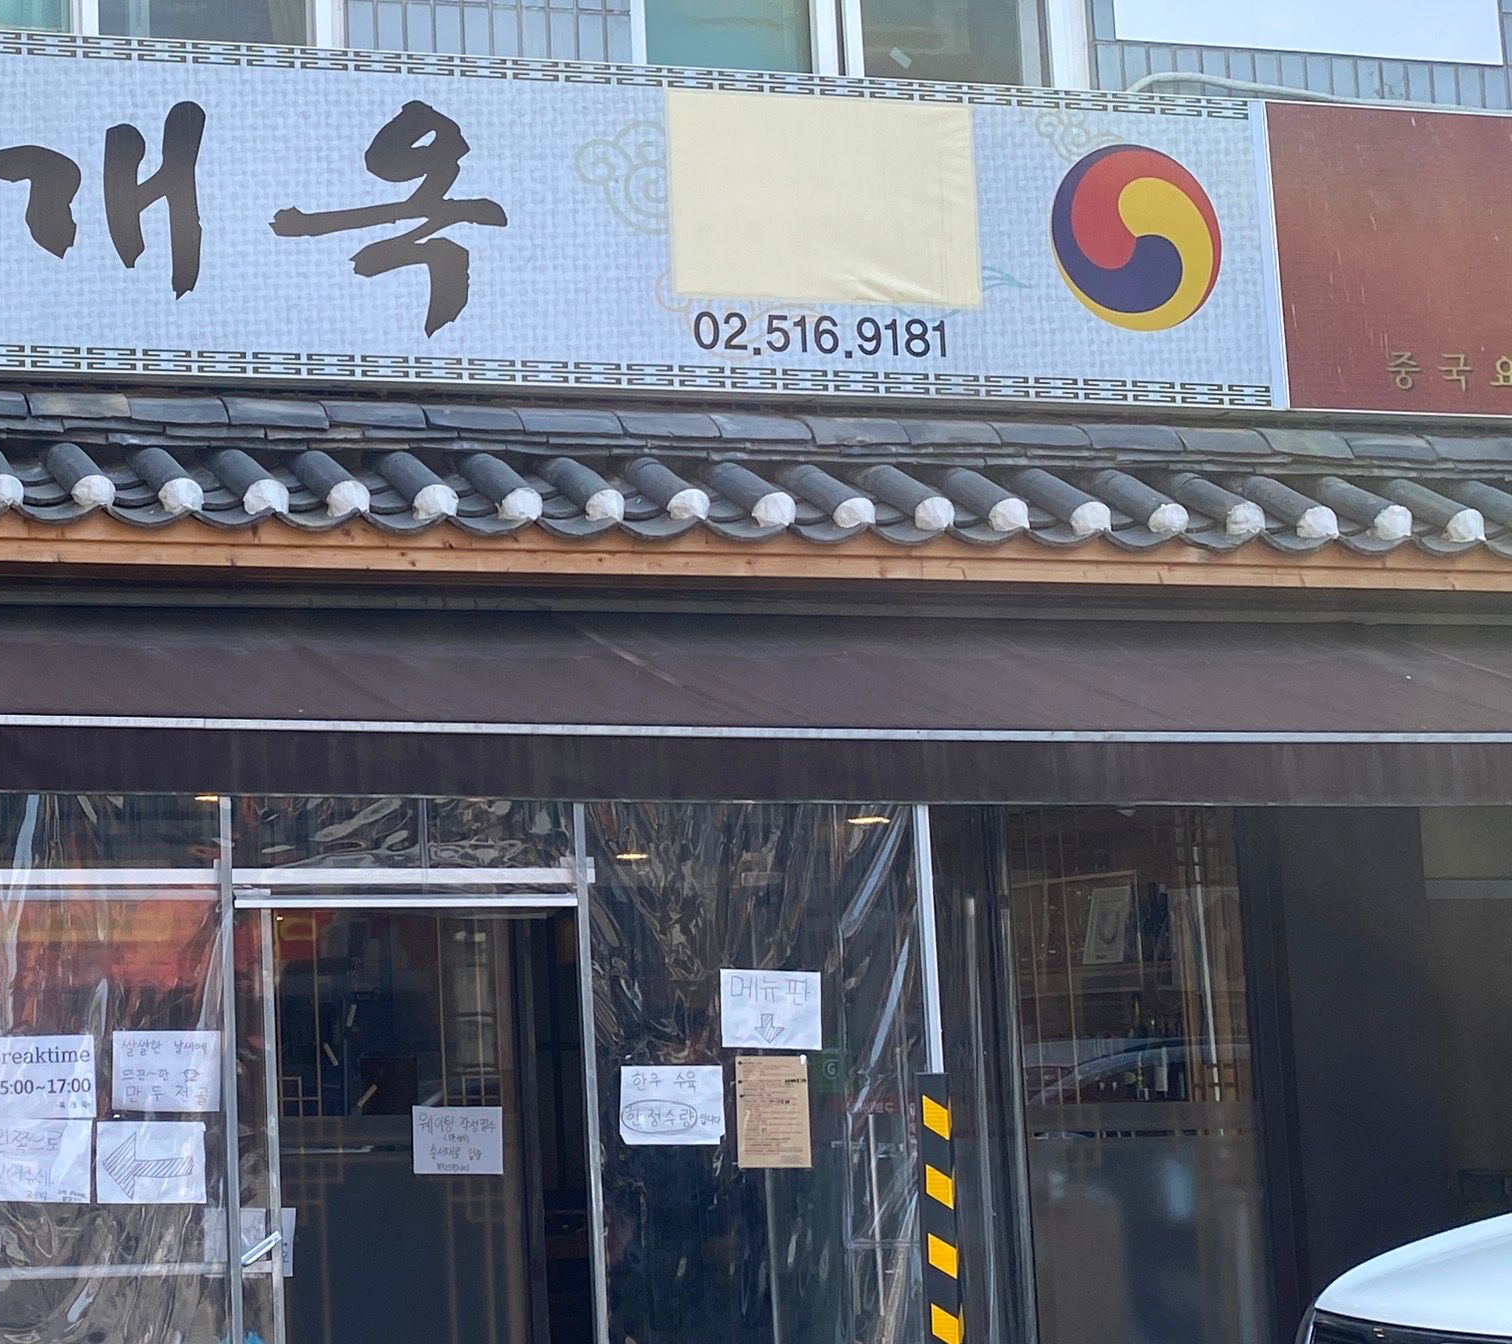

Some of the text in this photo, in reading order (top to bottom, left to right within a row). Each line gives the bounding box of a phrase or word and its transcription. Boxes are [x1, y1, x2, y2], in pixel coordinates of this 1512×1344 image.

[693, 309, 949, 362] 02.516.9181
[730, 975, 810, 1007] 메뉴판
[121, 1039, 162, 1057] 쌀쌀한
[632, 1071, 697, 1094] 한우 수육
[418, 1112, 454, 1134] 웨이팅
